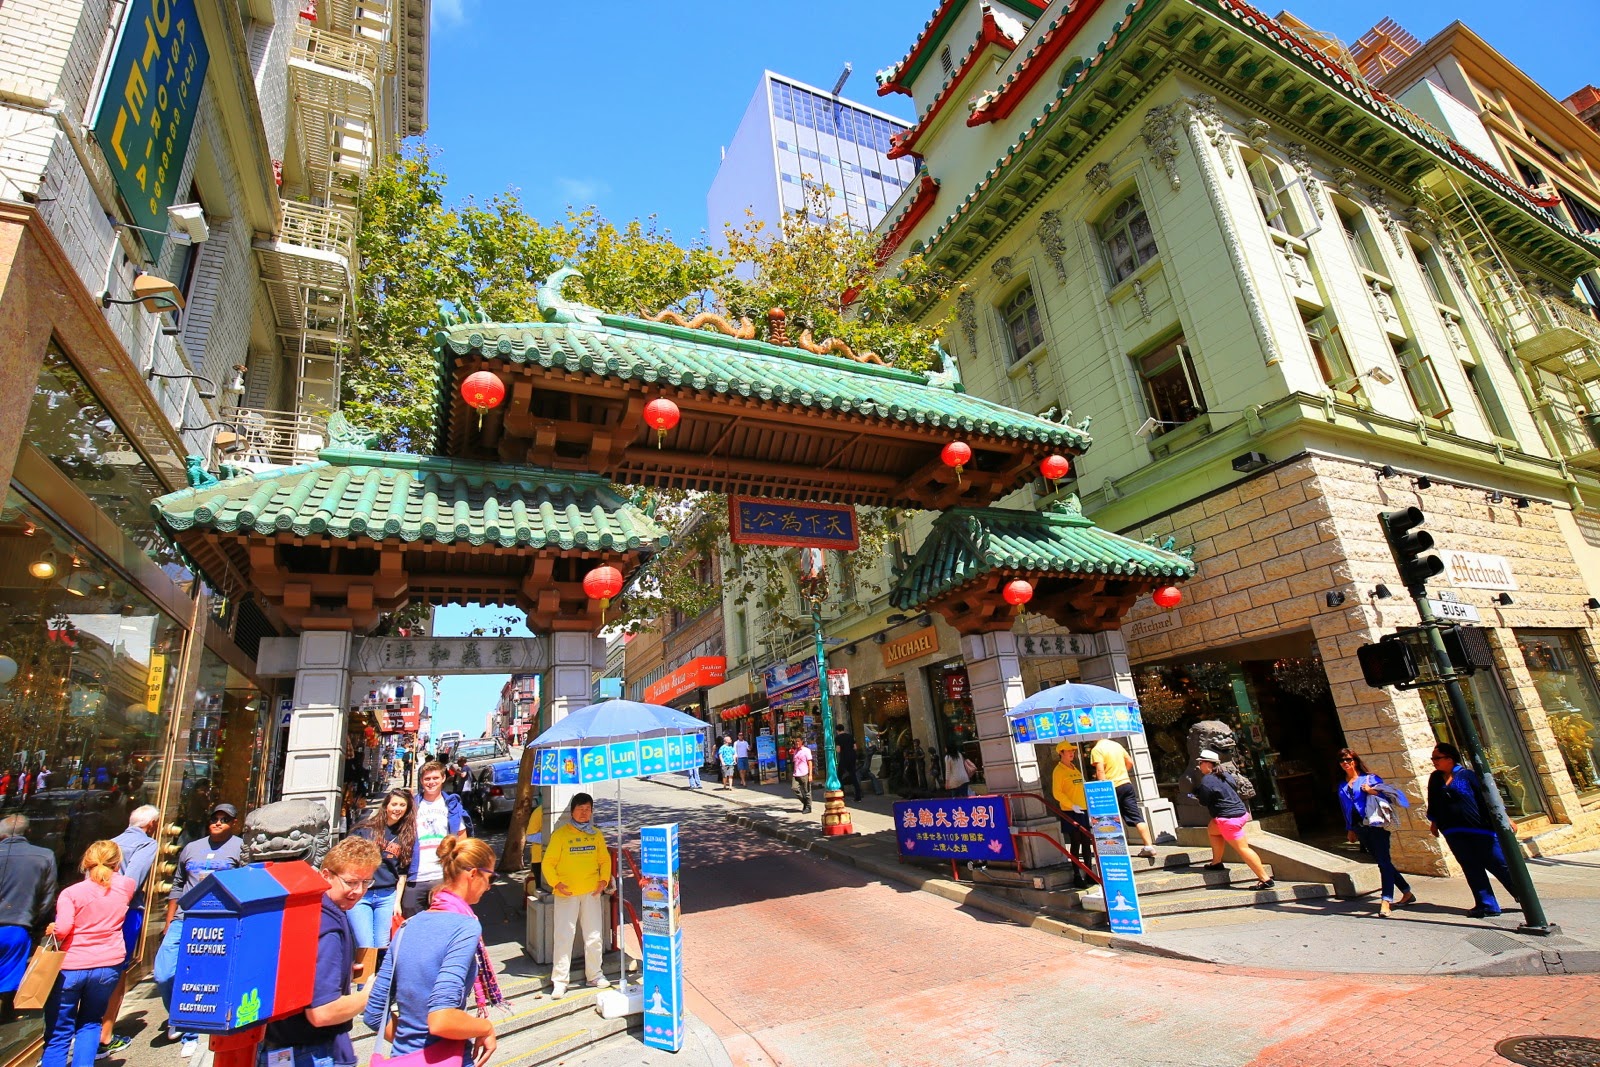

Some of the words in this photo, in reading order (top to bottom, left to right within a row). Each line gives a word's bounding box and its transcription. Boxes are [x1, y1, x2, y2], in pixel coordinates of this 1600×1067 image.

[111, 0, 177, 171] OTEL
[135, 18, 186, 193] ASTORIA
[1451, 554, 1510, 584] Michael
[1441, 604, 1468, 618] BUSH
[1130, 615, 1174, 639] Michael
[887, 635, 933, 663] MICHAEL
[583, 753, 605, 768] Fa
[611, 749, 636, 764] Lun
[641, 745, 664, 760] Da
[669, 742, 681, 756] Fa
[685, 741, 693, 755] is
[191, 927, 225, 941] POLICE
[186, 943, 227, 956] TELEPHONE
[181, 983, 221, 993] DEPARTMENT
[195, 993, 204, 1002] OF
[179, 1003, 217, 1013] ELECTRICITY
